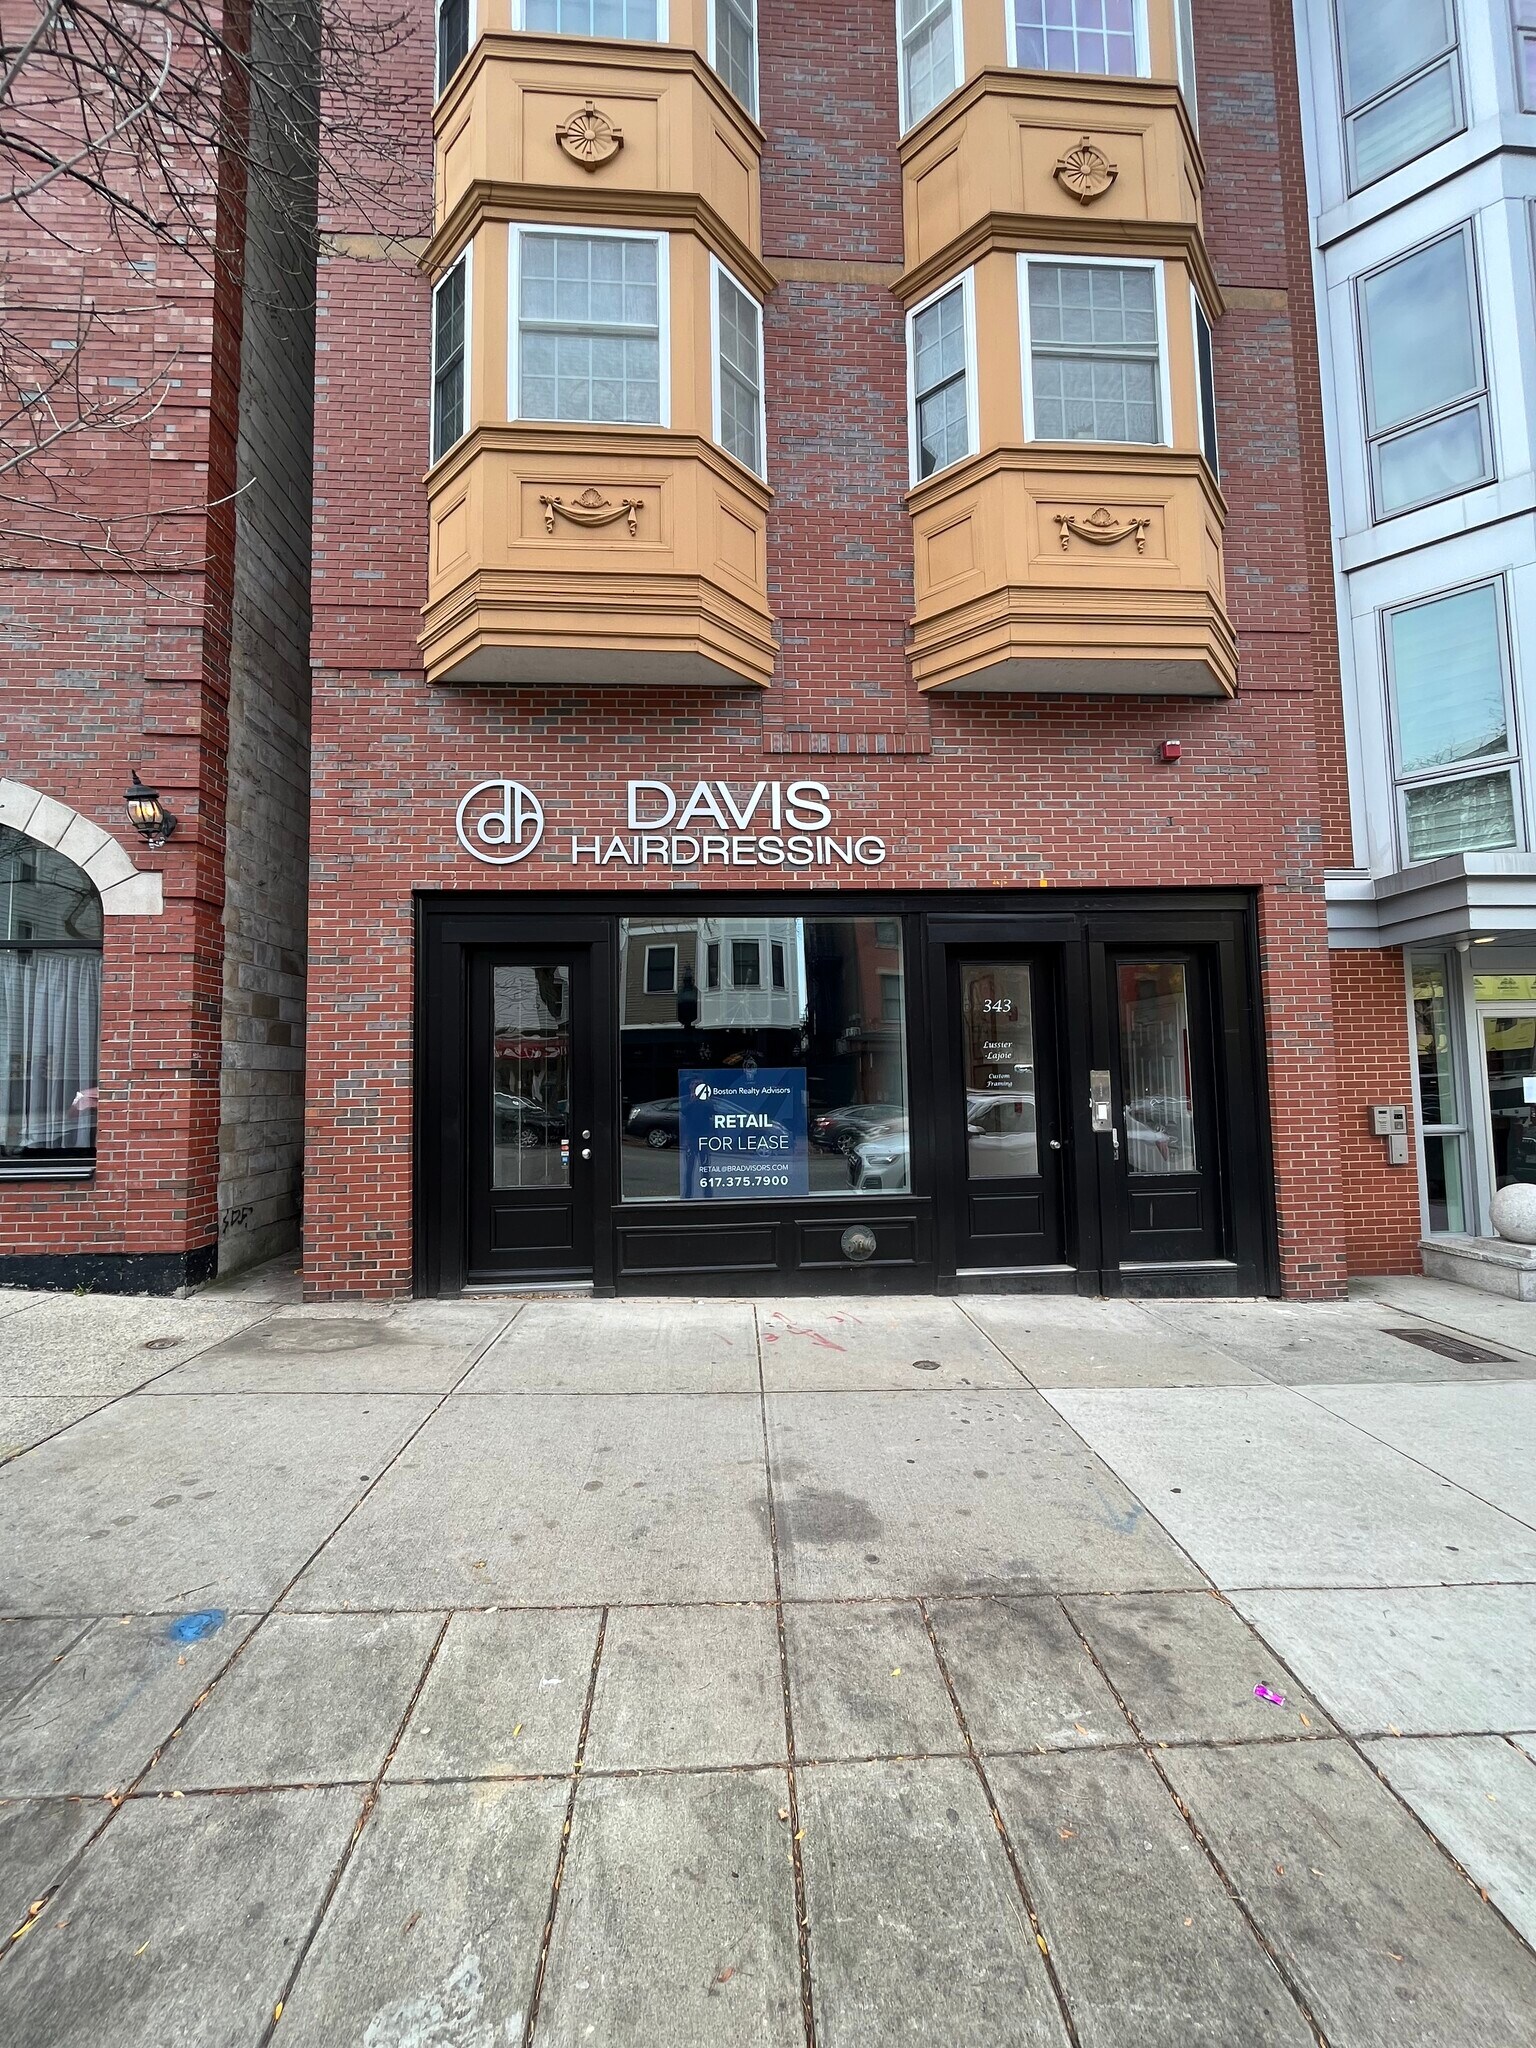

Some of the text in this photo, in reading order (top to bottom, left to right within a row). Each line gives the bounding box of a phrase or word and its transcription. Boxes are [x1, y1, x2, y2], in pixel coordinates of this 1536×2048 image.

[626, 780, 832, 831] DAVIS
[572, 835, 886, 866] HAIRDRESSING
[983, 999, 1011, 1013] 343
[983, 1041, 1013, 1049] Lussier
[713, 1086, 791, 1096] Boston Realty Advisors
[714, 1114, 773, 1128] RETAIL
[698, 1135, 789, 1151] FOR LEASE
[699, 1164, 789, 1173] RETAIL@BRADVISORS.COM
[699, 1175, 789, 1188] 617.375.7900
